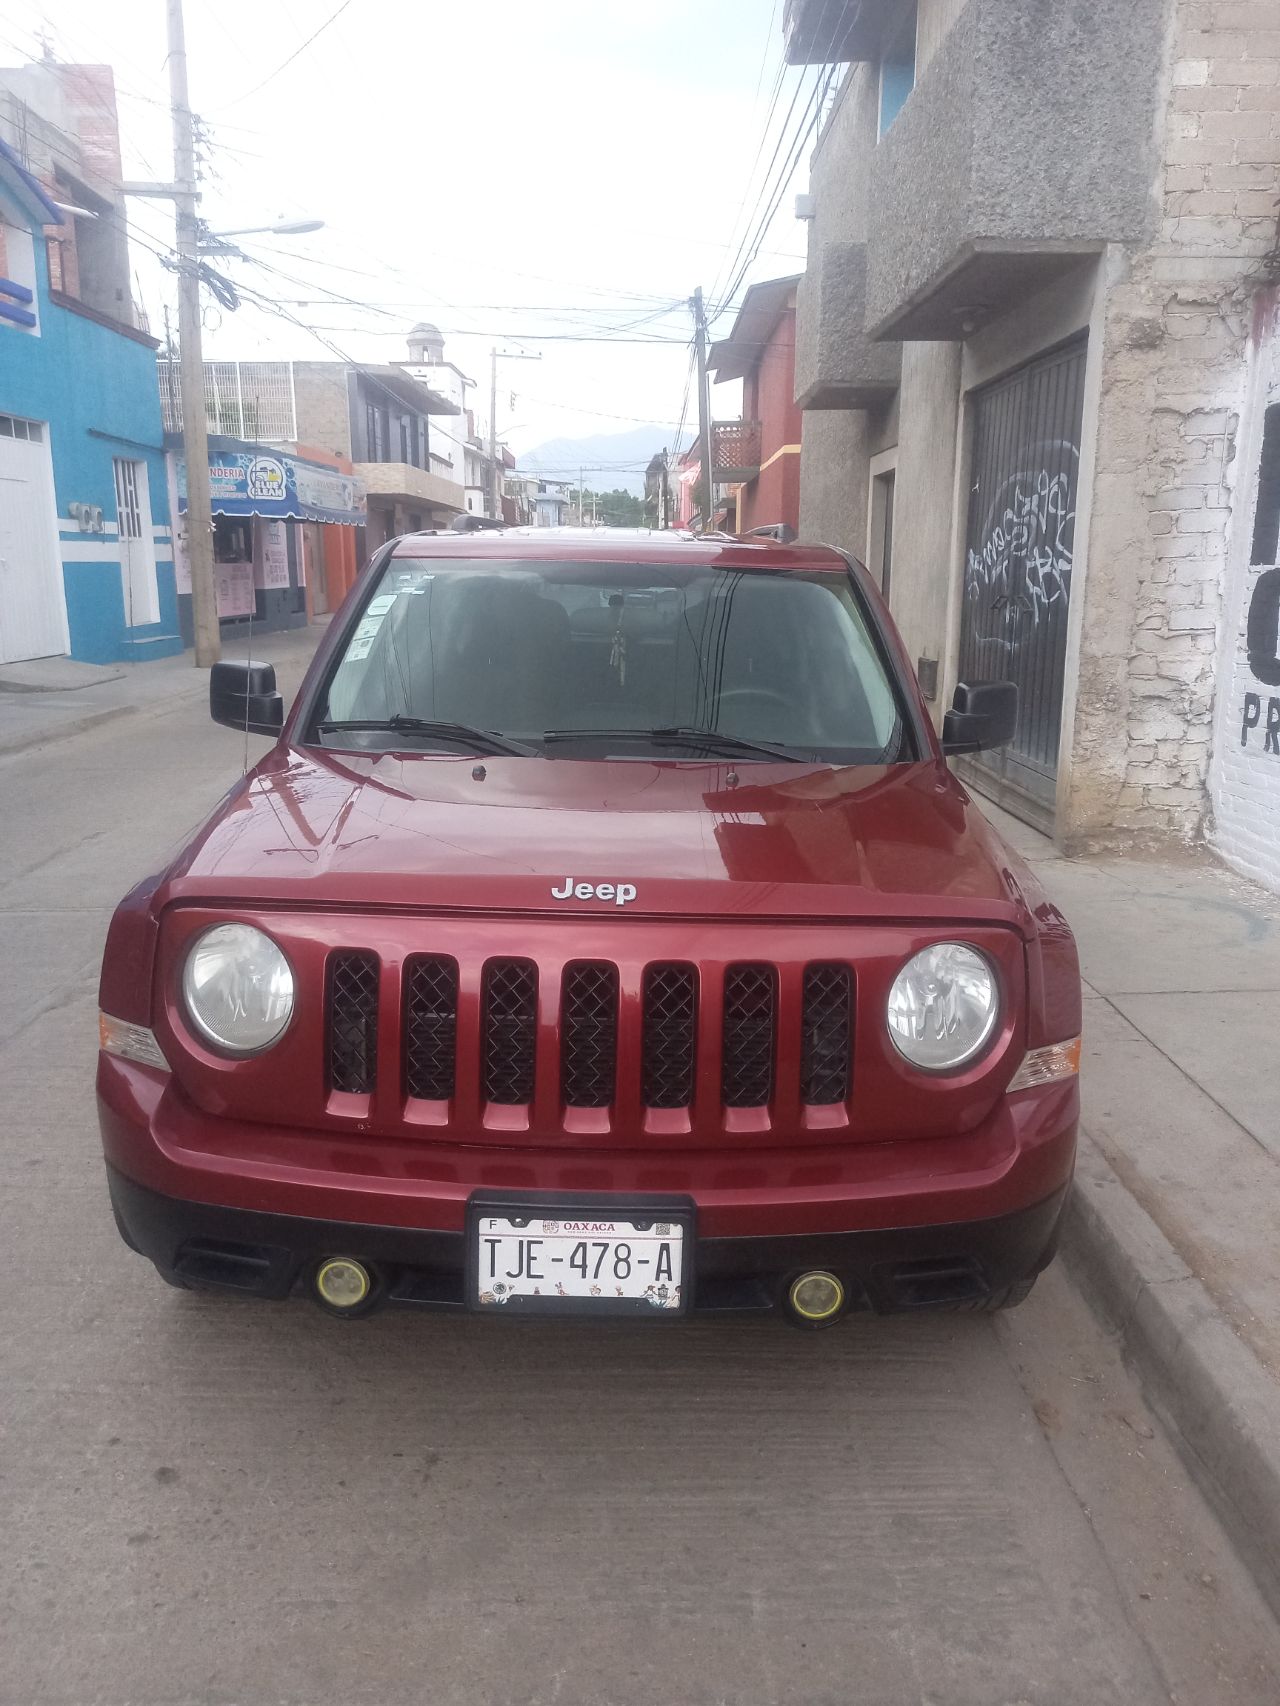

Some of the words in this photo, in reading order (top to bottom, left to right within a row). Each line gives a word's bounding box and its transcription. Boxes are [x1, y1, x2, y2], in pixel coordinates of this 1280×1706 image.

[210, 468, 244, 478] NDERIA
[254, 480, 279, 489] BLUE
[251, 487, 283, 497] CLEAN
[551, 877, 637, 906] Jeep
[489, 1219, 497, 1230] F
[563, 1222, 616, 1231] OAXACA
[484, 1239, 672, 1282] TJE-478-A
